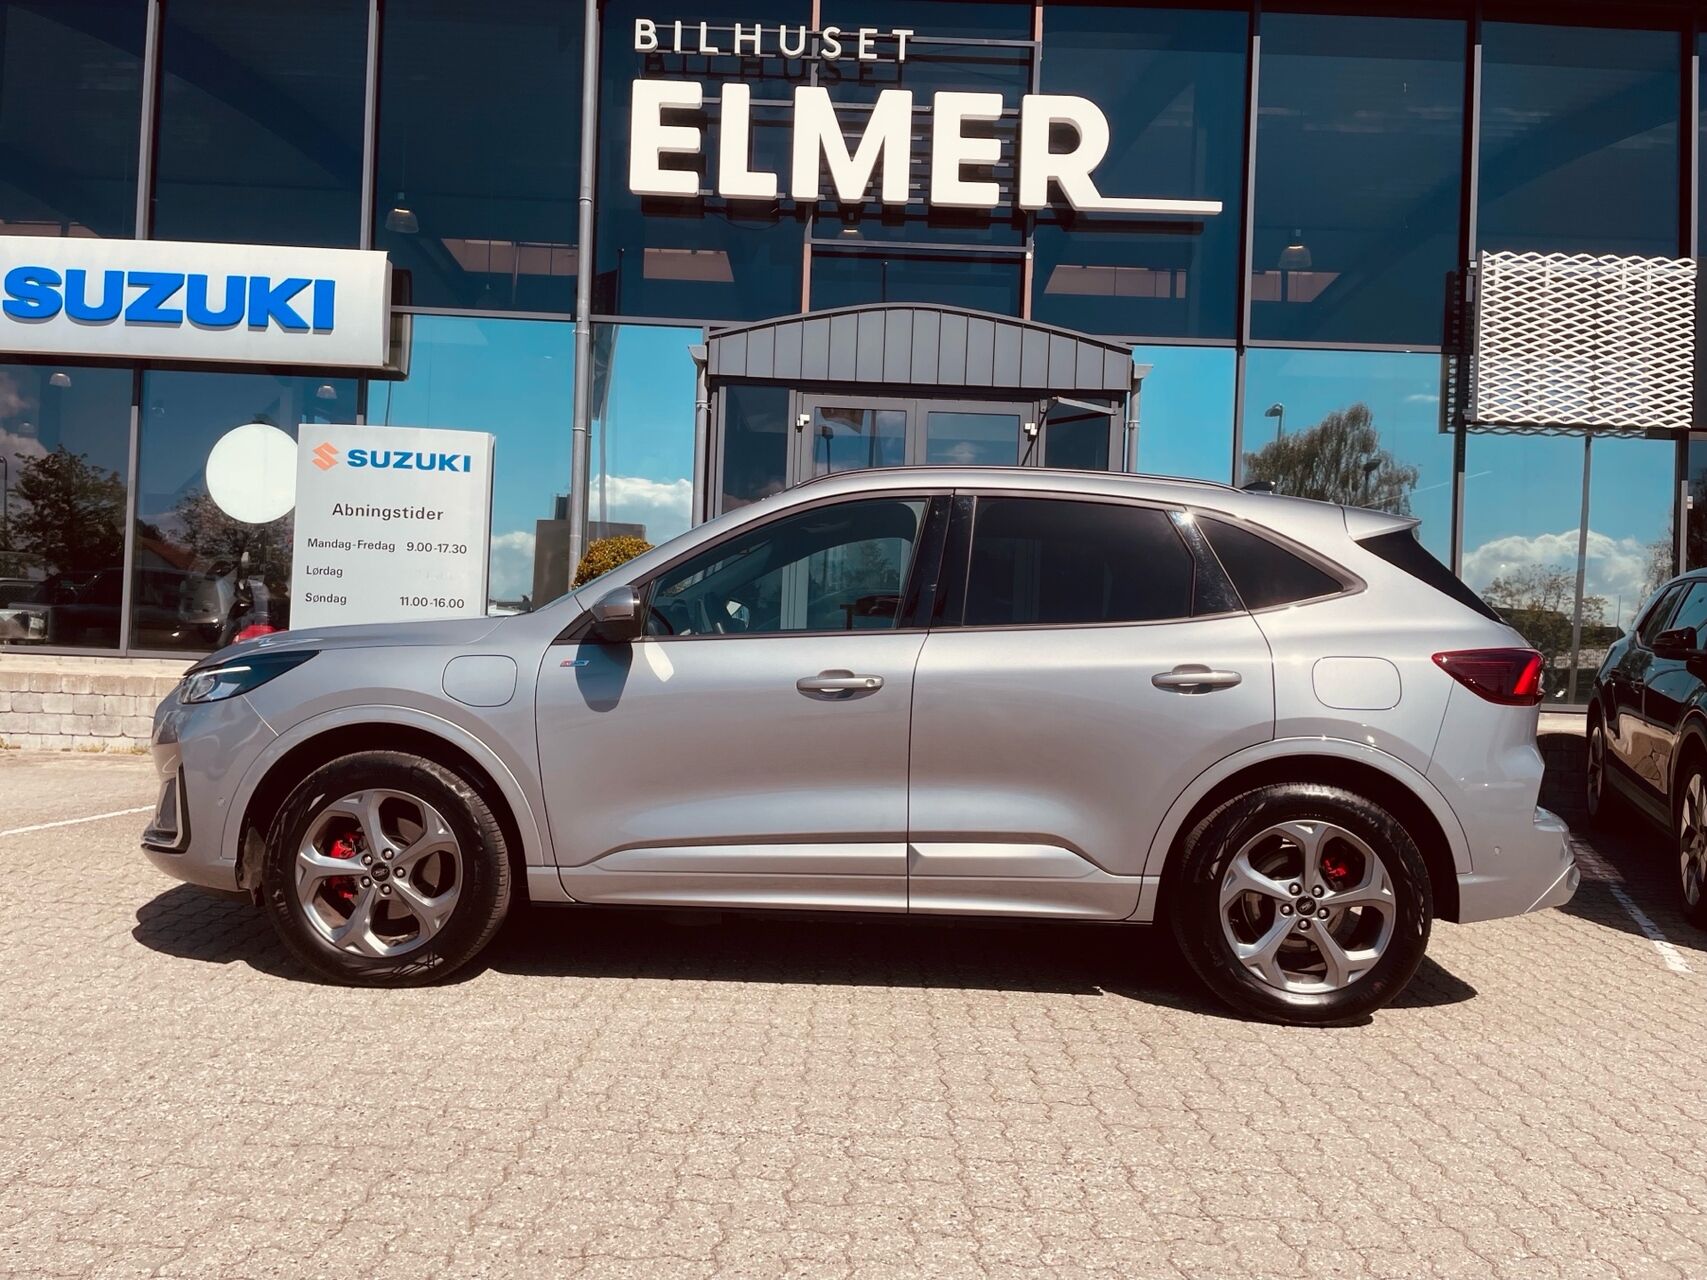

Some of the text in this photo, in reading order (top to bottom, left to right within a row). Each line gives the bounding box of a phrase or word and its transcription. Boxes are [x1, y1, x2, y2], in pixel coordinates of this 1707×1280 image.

[634, 19, 914, 62] BILHUSET
[629, 79, 1222, 215] ELMER
[2, 266, 336, 332] SUZUKI
[347, 449, 472, 473] SUZUKI
[306, 565, 343, 578] Lørdag
[305, 592, 347, 606] Søndag
